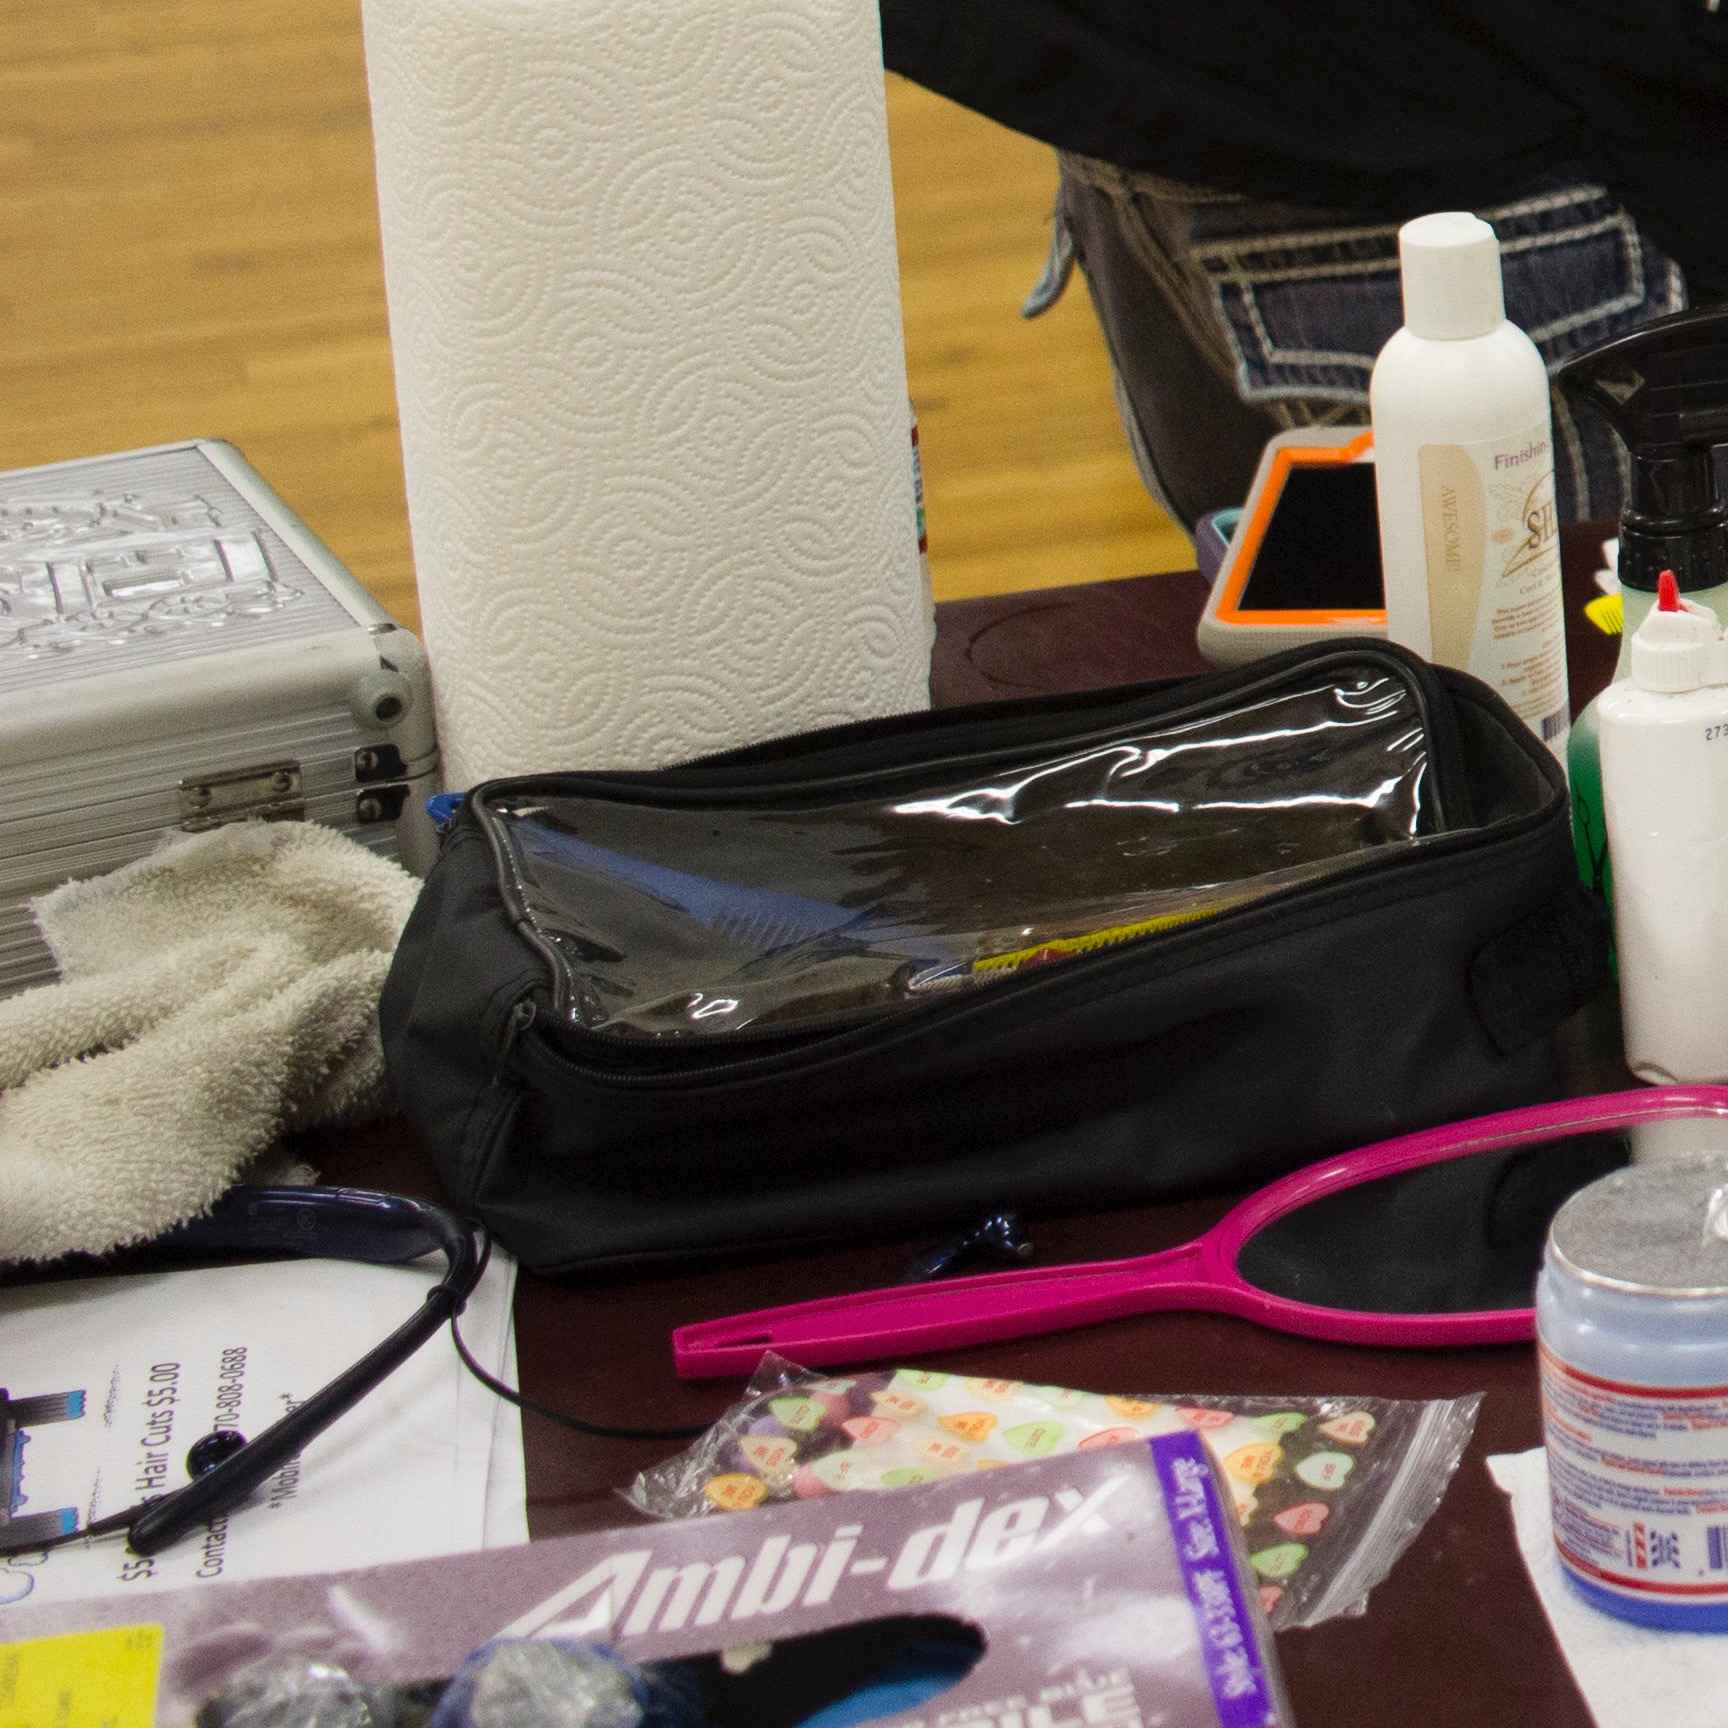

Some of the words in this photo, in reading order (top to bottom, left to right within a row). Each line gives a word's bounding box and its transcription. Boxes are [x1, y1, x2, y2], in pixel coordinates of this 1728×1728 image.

[1441, 485, 1461, 572] AWESOME
[141, 1362, 181, 1407] $5.00
[213, 1346, 248, 1432] 70-808-0688
[140, 1409, 175, 1448] Cuts
[135, 1451, 170, 1491] Hair
[500, 1475, 1126, 1638] Ambi-dex
